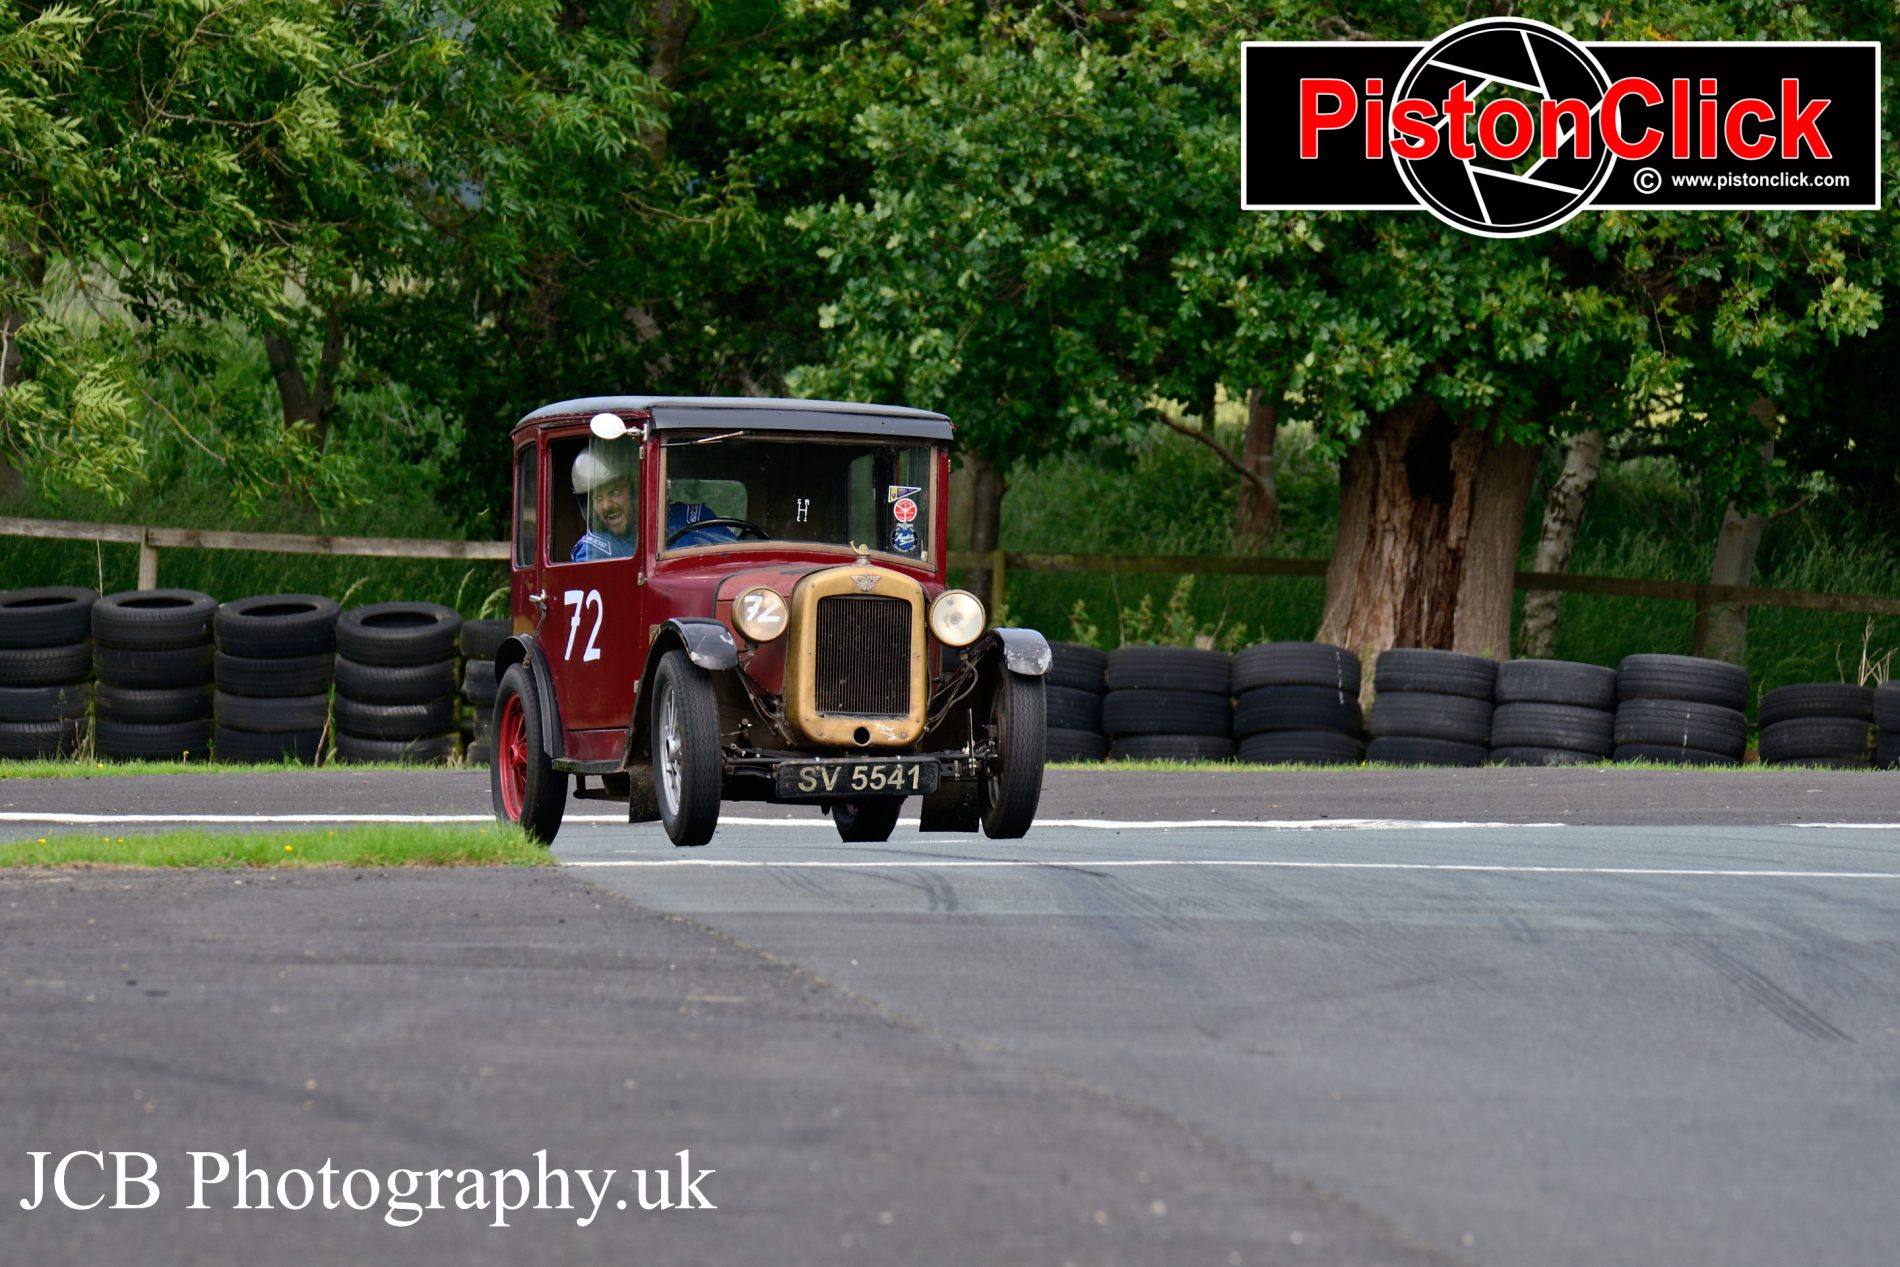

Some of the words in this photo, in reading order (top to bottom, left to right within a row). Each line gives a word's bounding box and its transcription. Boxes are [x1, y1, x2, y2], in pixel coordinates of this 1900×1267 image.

[744, 595, 781, 623] 72
[564, 589, 603, 662] 72
[798, 766, 842, 792] SV
[851, 764, 920, 791] 5541
